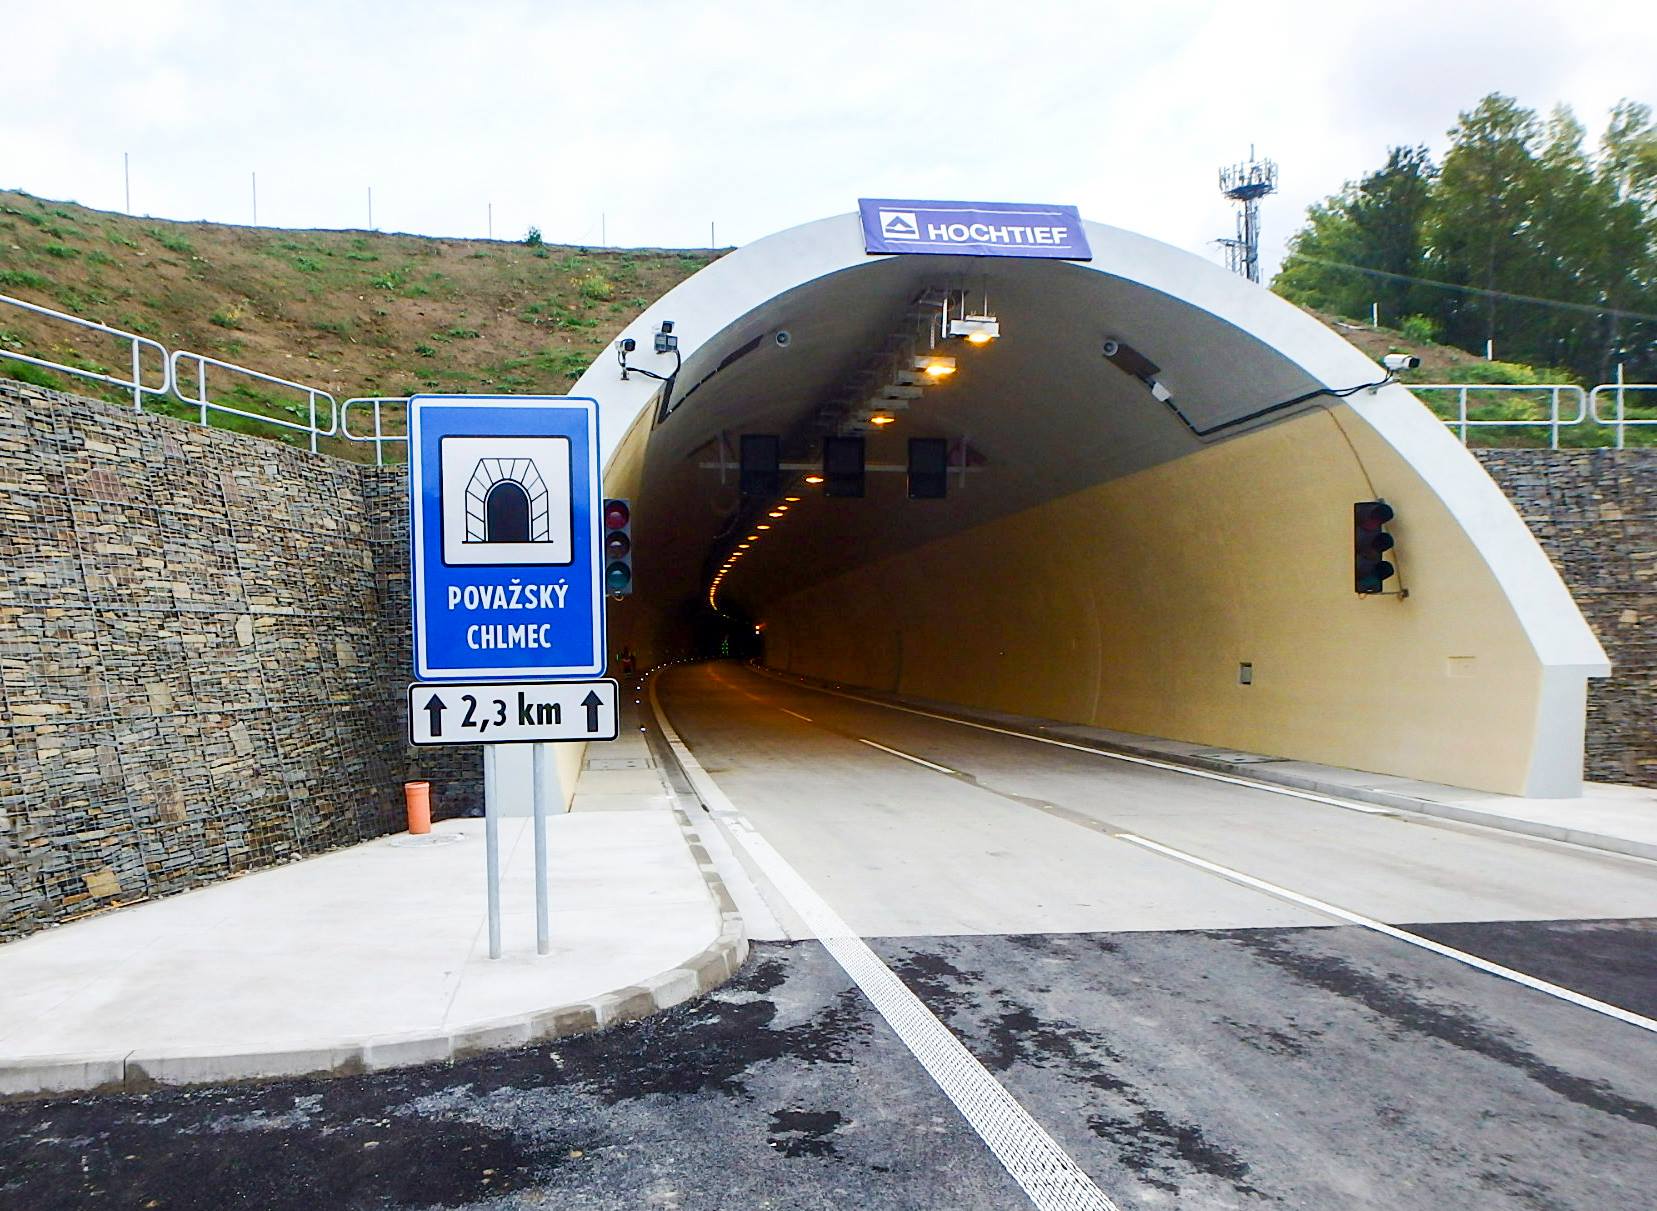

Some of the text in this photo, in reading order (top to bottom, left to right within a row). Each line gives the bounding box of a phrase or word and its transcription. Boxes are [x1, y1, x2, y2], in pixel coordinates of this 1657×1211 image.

[927, 223, 1068, 244] HOCHTIEF
[448, 578, 569, 610] POVAŽSKÝ
[466, 624, 552, 649] CHLMEC
[461, 691, 562, 733] 2,3 km
